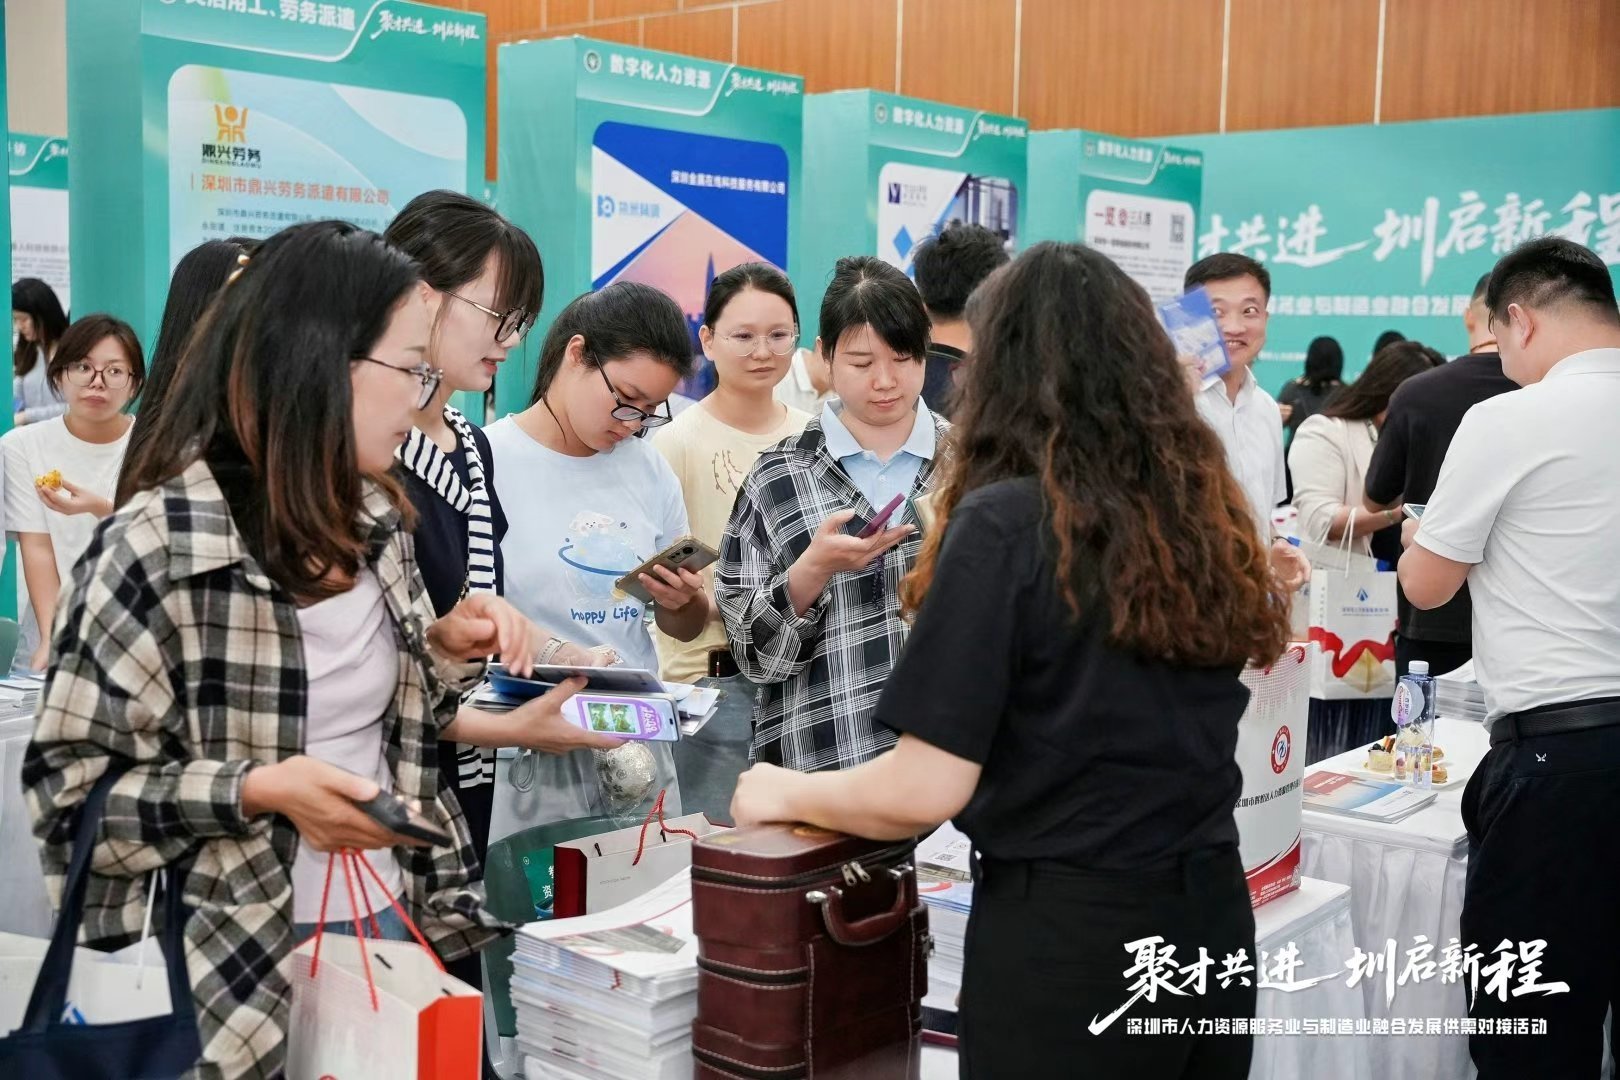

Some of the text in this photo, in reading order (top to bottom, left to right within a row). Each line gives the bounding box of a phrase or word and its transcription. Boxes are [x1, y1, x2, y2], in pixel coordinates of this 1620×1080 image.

[186, 0, 355, 30] 活用工、劳务派遣
[609, 53, 712, 90] 数字化人力资源
[892, 106, 965, 135] 数字化人力资源
[202, 143, 262, 162] 鼎兴劳务
[202, 173, 389, 206] 深圳市鼎兴劳务派遣有限公司
[571, 605, 639, 624] happy Life
